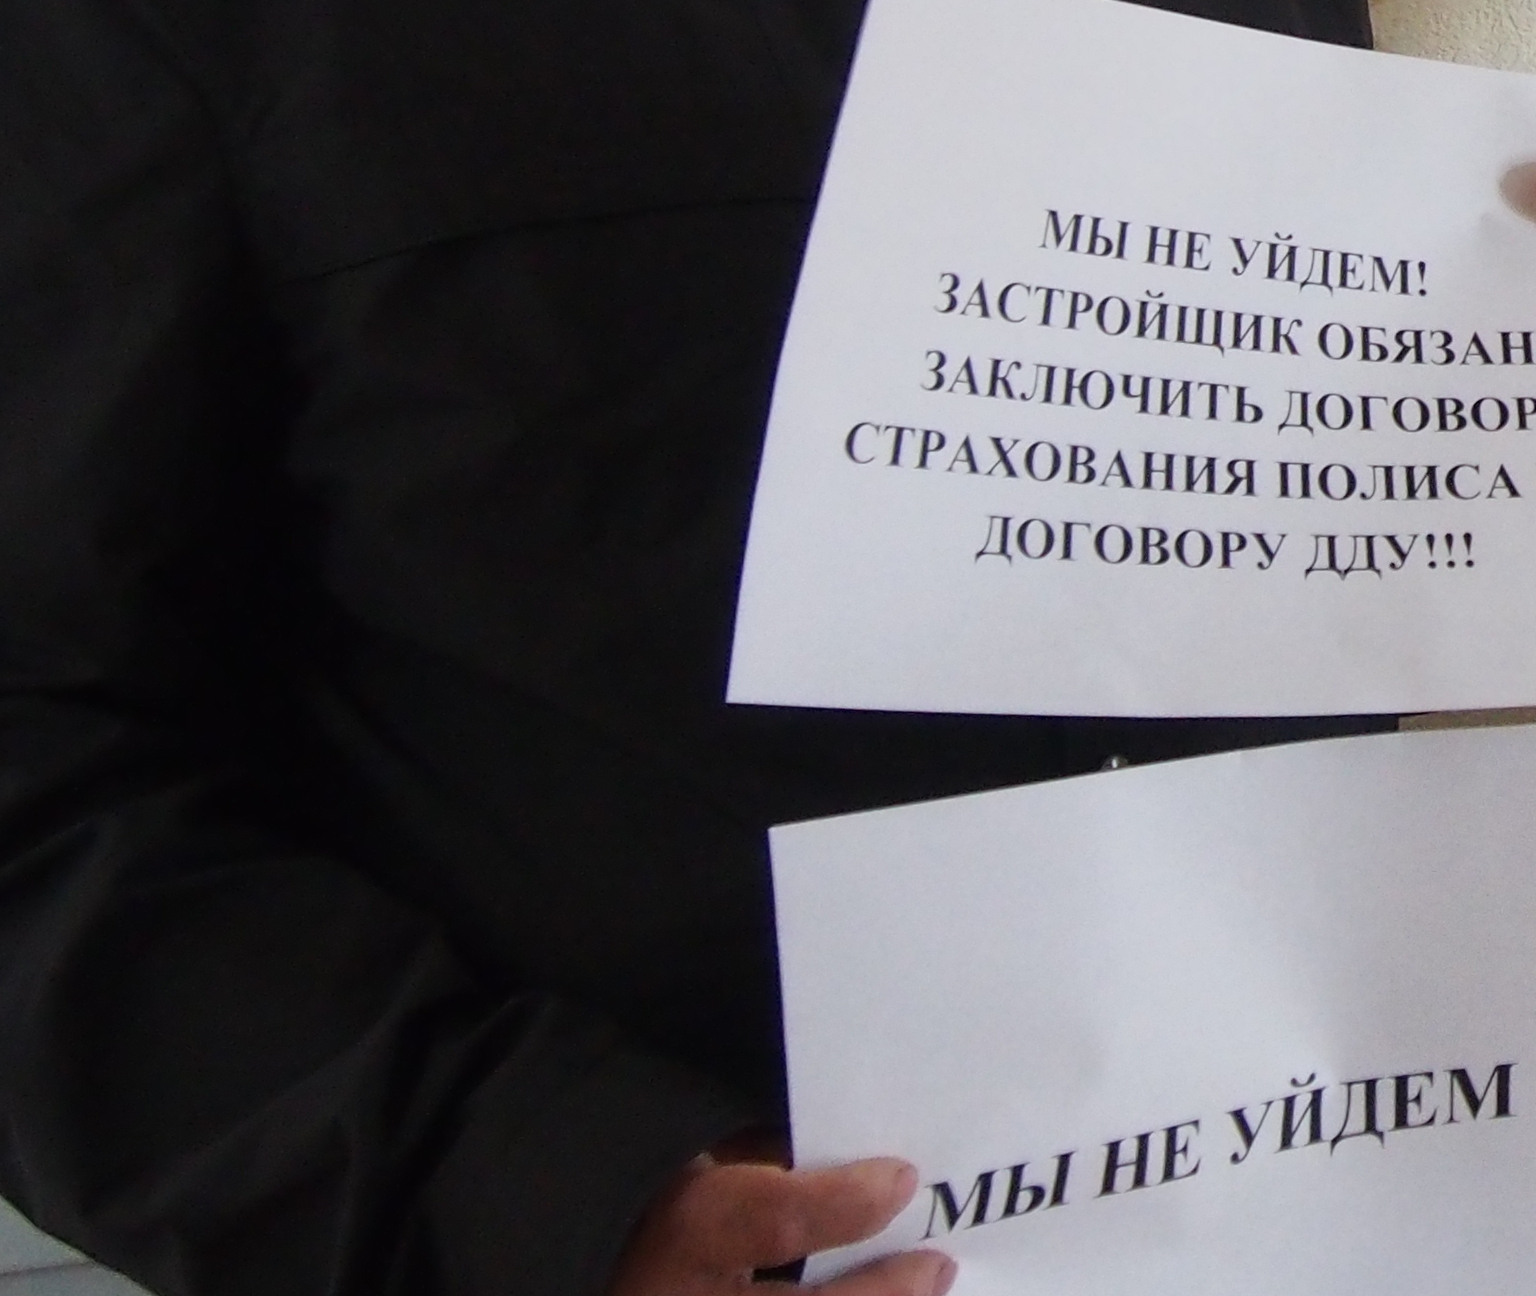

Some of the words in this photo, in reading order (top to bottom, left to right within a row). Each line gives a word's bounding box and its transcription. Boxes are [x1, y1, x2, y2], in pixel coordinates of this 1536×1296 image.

[1041, 209, 1130, 260] МЫ
[1145, 225, 1211, 271] НЕ
[1231, 232, 1427, 297] УЙДЕМ!
[932, 272, 1303, 357] ЗАСТРОЙЩИК
[1318, 322, 1534, 366] ОБЯЗАН
[919, 350, 1265, 424] ЗАКЛЮЧИТЬ
[845, 422, 1256, 497] СТРАХОВАНИЯ
[1279, 461, 1521, 501] ПОЛИСА
[975, 515, 1287, 571] ДОГОВОРУ
[1304, 532, 1475, 578] ДДУ!!!
[919, 1151, 1074, 1240] МЫ
[1095, 1119, 1202, 1198] НЕ
[1228, 1062, 1517, 1165] УЙДЕМ
